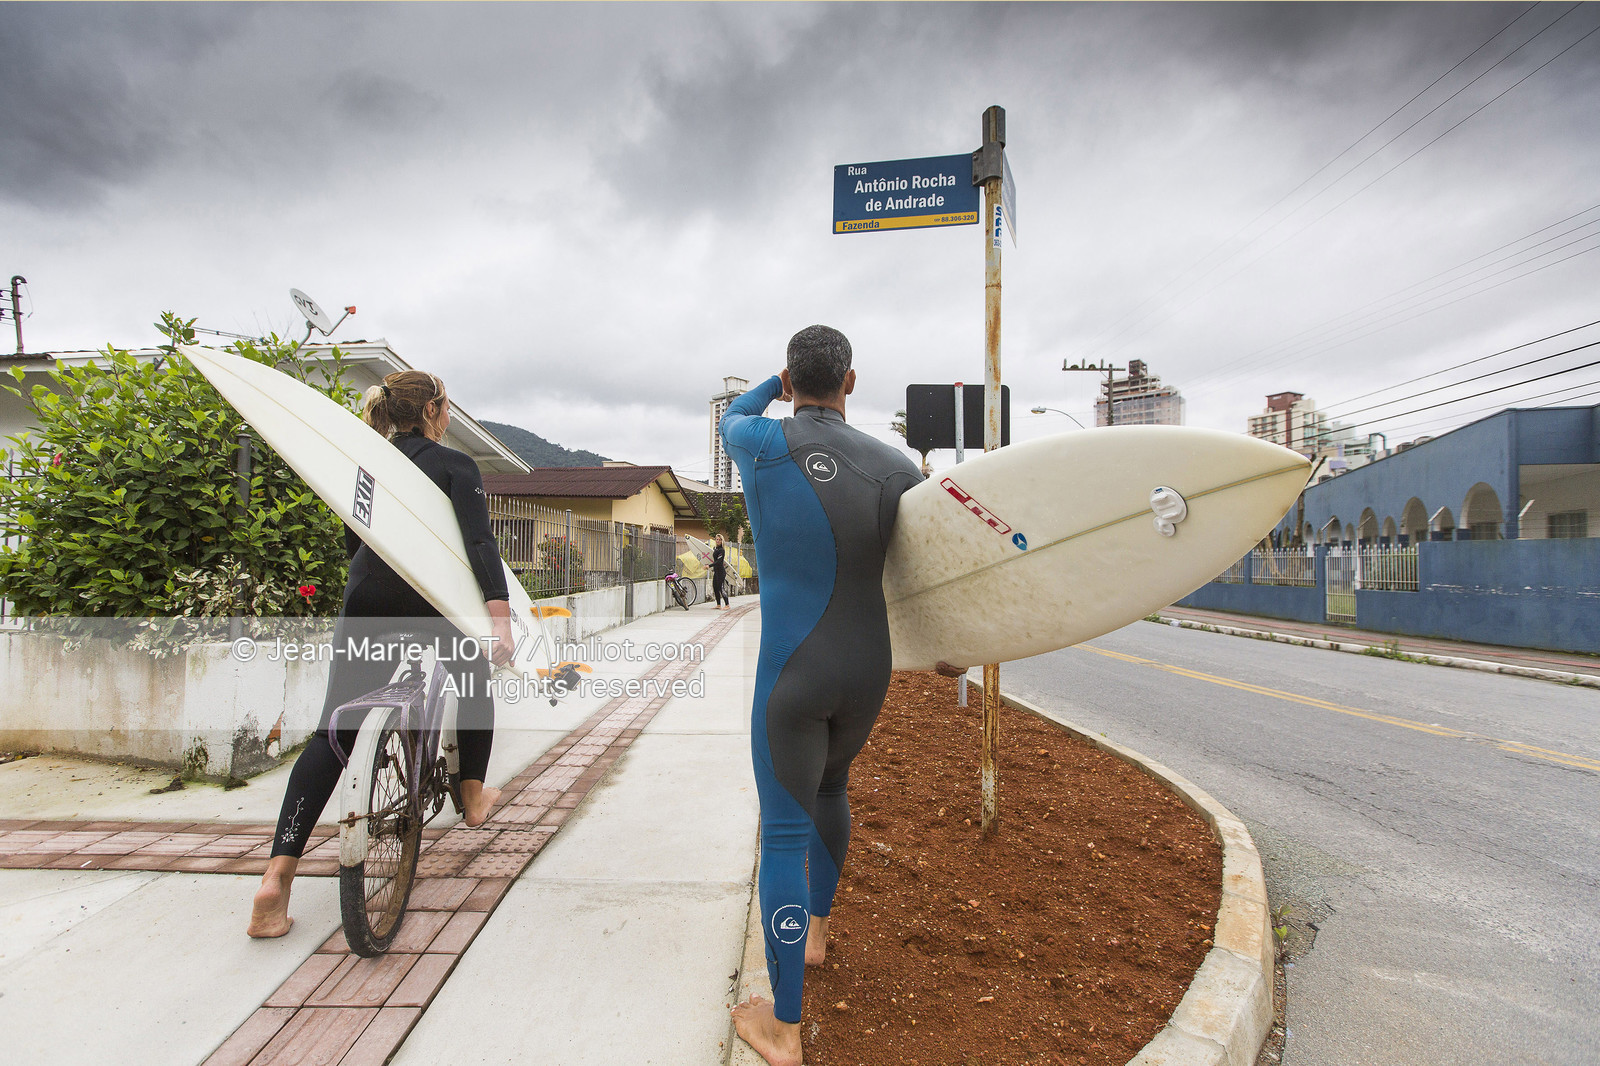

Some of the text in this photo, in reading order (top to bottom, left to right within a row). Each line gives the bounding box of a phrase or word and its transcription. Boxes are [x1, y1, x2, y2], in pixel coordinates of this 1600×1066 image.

[848, 166, 867, 176] Rua
[854, 174, 956, 193] Antônio Rocha
[865, 194, 944, 212] de Andrade
[842, 220, 880, 230] Fazenda
